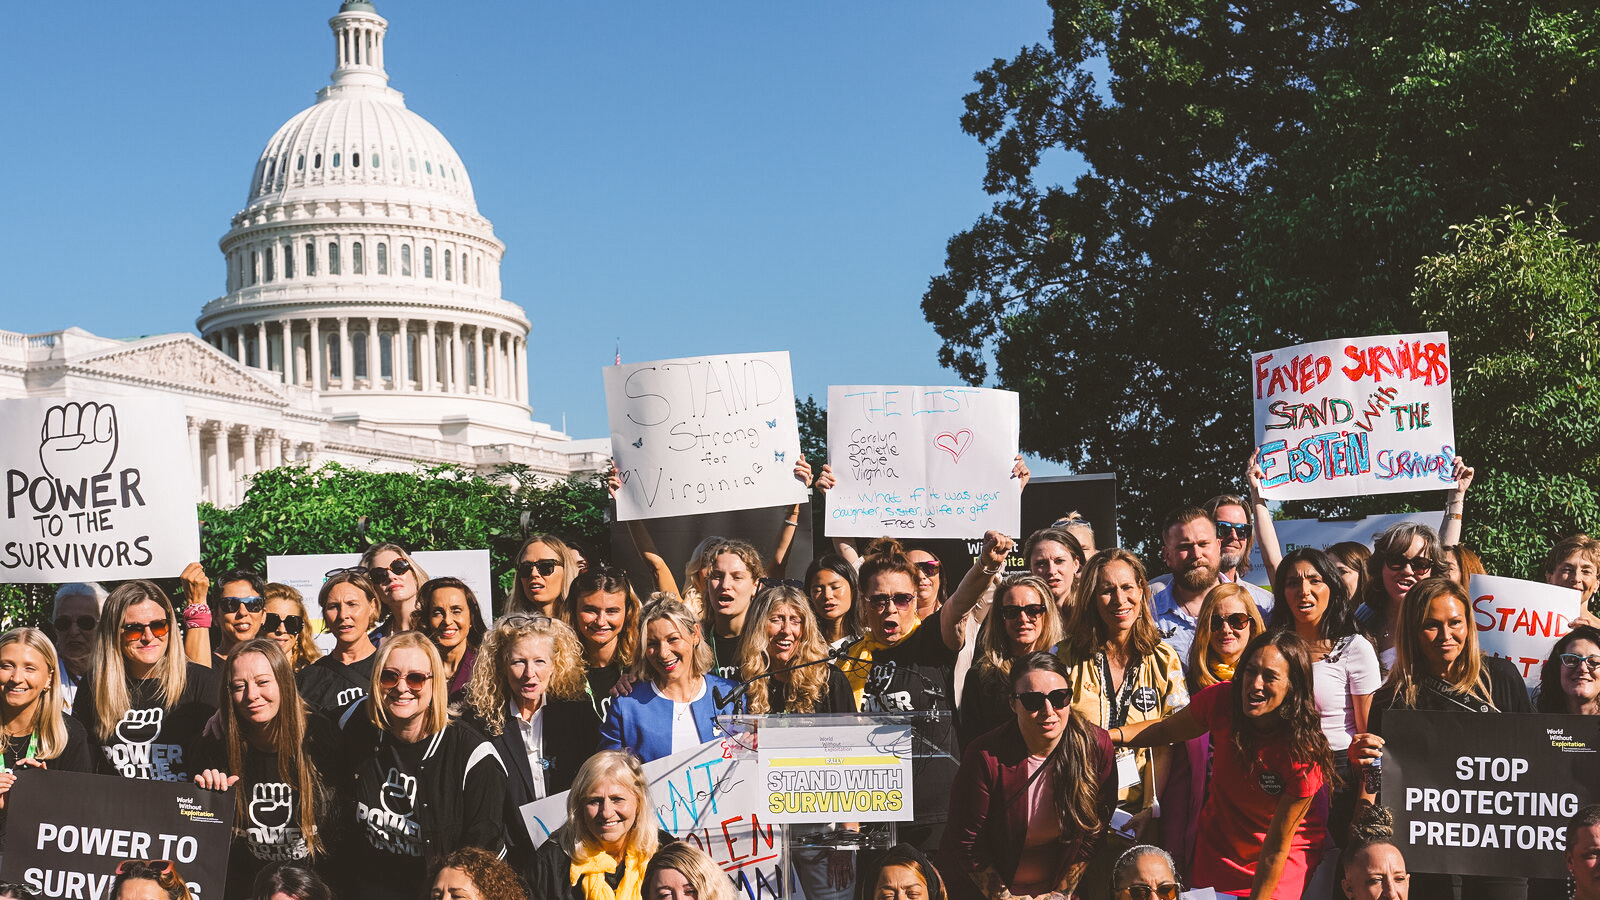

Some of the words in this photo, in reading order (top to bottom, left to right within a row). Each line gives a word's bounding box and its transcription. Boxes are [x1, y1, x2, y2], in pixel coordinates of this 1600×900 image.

[1255, 353, 1332, 399] FAYED
[625, 360, 782, 426] STAND
[845, 391, 902, 423] THE
[912, 389, 981, 416] LIST
[1265, 397, 1354, 431] STAND
[1390, 402, 1432, 431] THE
[669, 421, 760, 451] Strong
[851, 428, 898, 450] Carolyn
[701, 451, 727, 465] for
[7, 468, 146, 519] POWER
[634, 467, 755, 507] Virginia
[944, 490, 971, 501] was
[33, 514, 63, 538] TO
[69, 508, 114, 534] THE
[0, 535, 153, 571] SURVIVORS
[1472, 594, 1571, 638] STAND
[101, 743, 183, 764] POWER
[825, 757, 845, 765] RALLY
[767, 771, 841, 791] STAND
[844, 769, 903, 790] WITH
[1455, 756, 1529, 782] STOP
[176, 796, 194, 804] World
[179, 802, 202, 810] Without
[180, 809, 215, 817] Exploitation
[768, 790, 903, 813] SURVIVORS
[1405, 787, 1579, 818] PROTECTING
[36, 822, 151, 860] POWER
[158, 833, 198, 864] TO
[1409, 820, 1567, 851] PREDATORS
